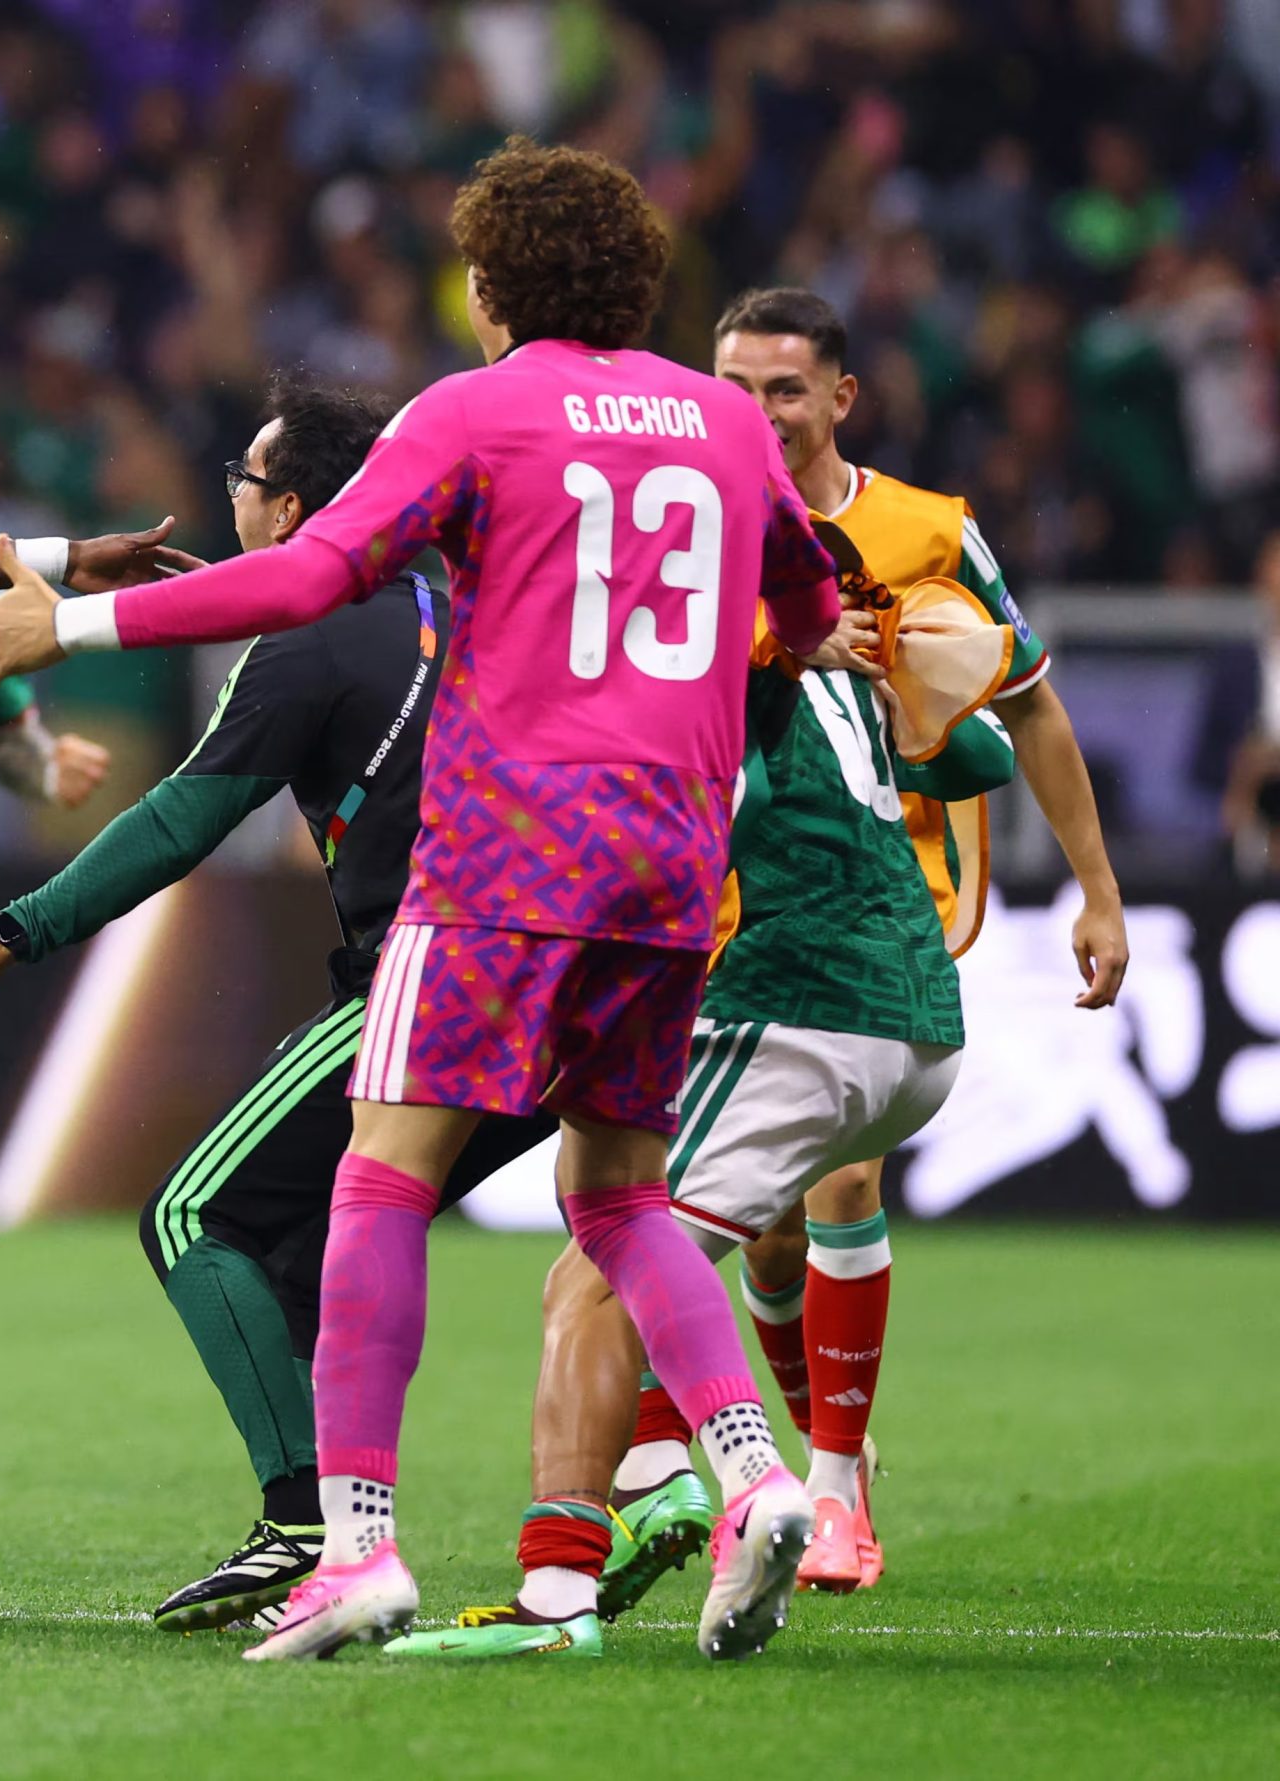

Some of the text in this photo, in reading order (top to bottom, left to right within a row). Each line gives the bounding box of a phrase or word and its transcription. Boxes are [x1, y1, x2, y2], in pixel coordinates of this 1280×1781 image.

[563, 461, 723, 681] 13
[364, 662, 429, 777] FIFA WORLD CUP 2026
